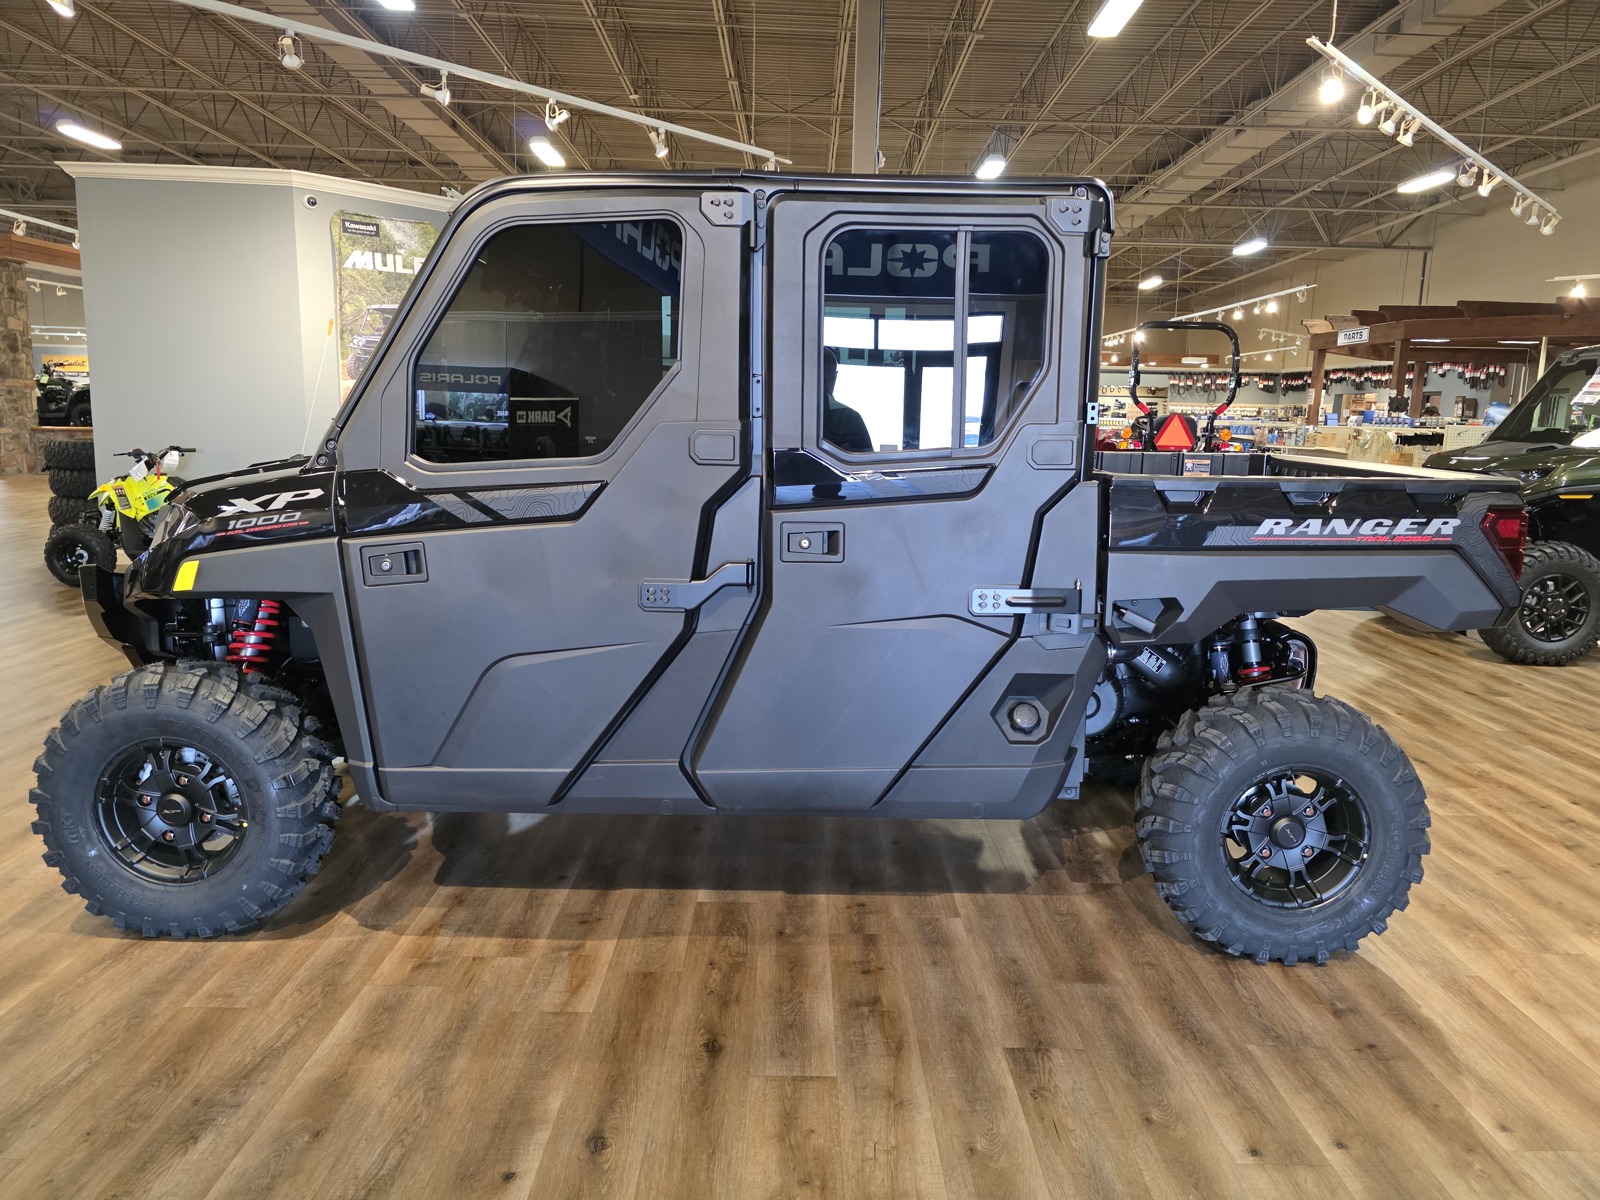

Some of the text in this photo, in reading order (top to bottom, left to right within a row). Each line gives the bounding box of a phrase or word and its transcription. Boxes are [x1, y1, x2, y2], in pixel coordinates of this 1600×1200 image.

[345, 221, 376, 231] Kawasaki
[1343, 331, 1363, 341] PARTS
[215, 488, 325, 517] XP
[227, 512, 302, 530] 1000
[1254, 518, 1462, 535] RANGER
[245, 524, 281, 533] OVERHEAD
